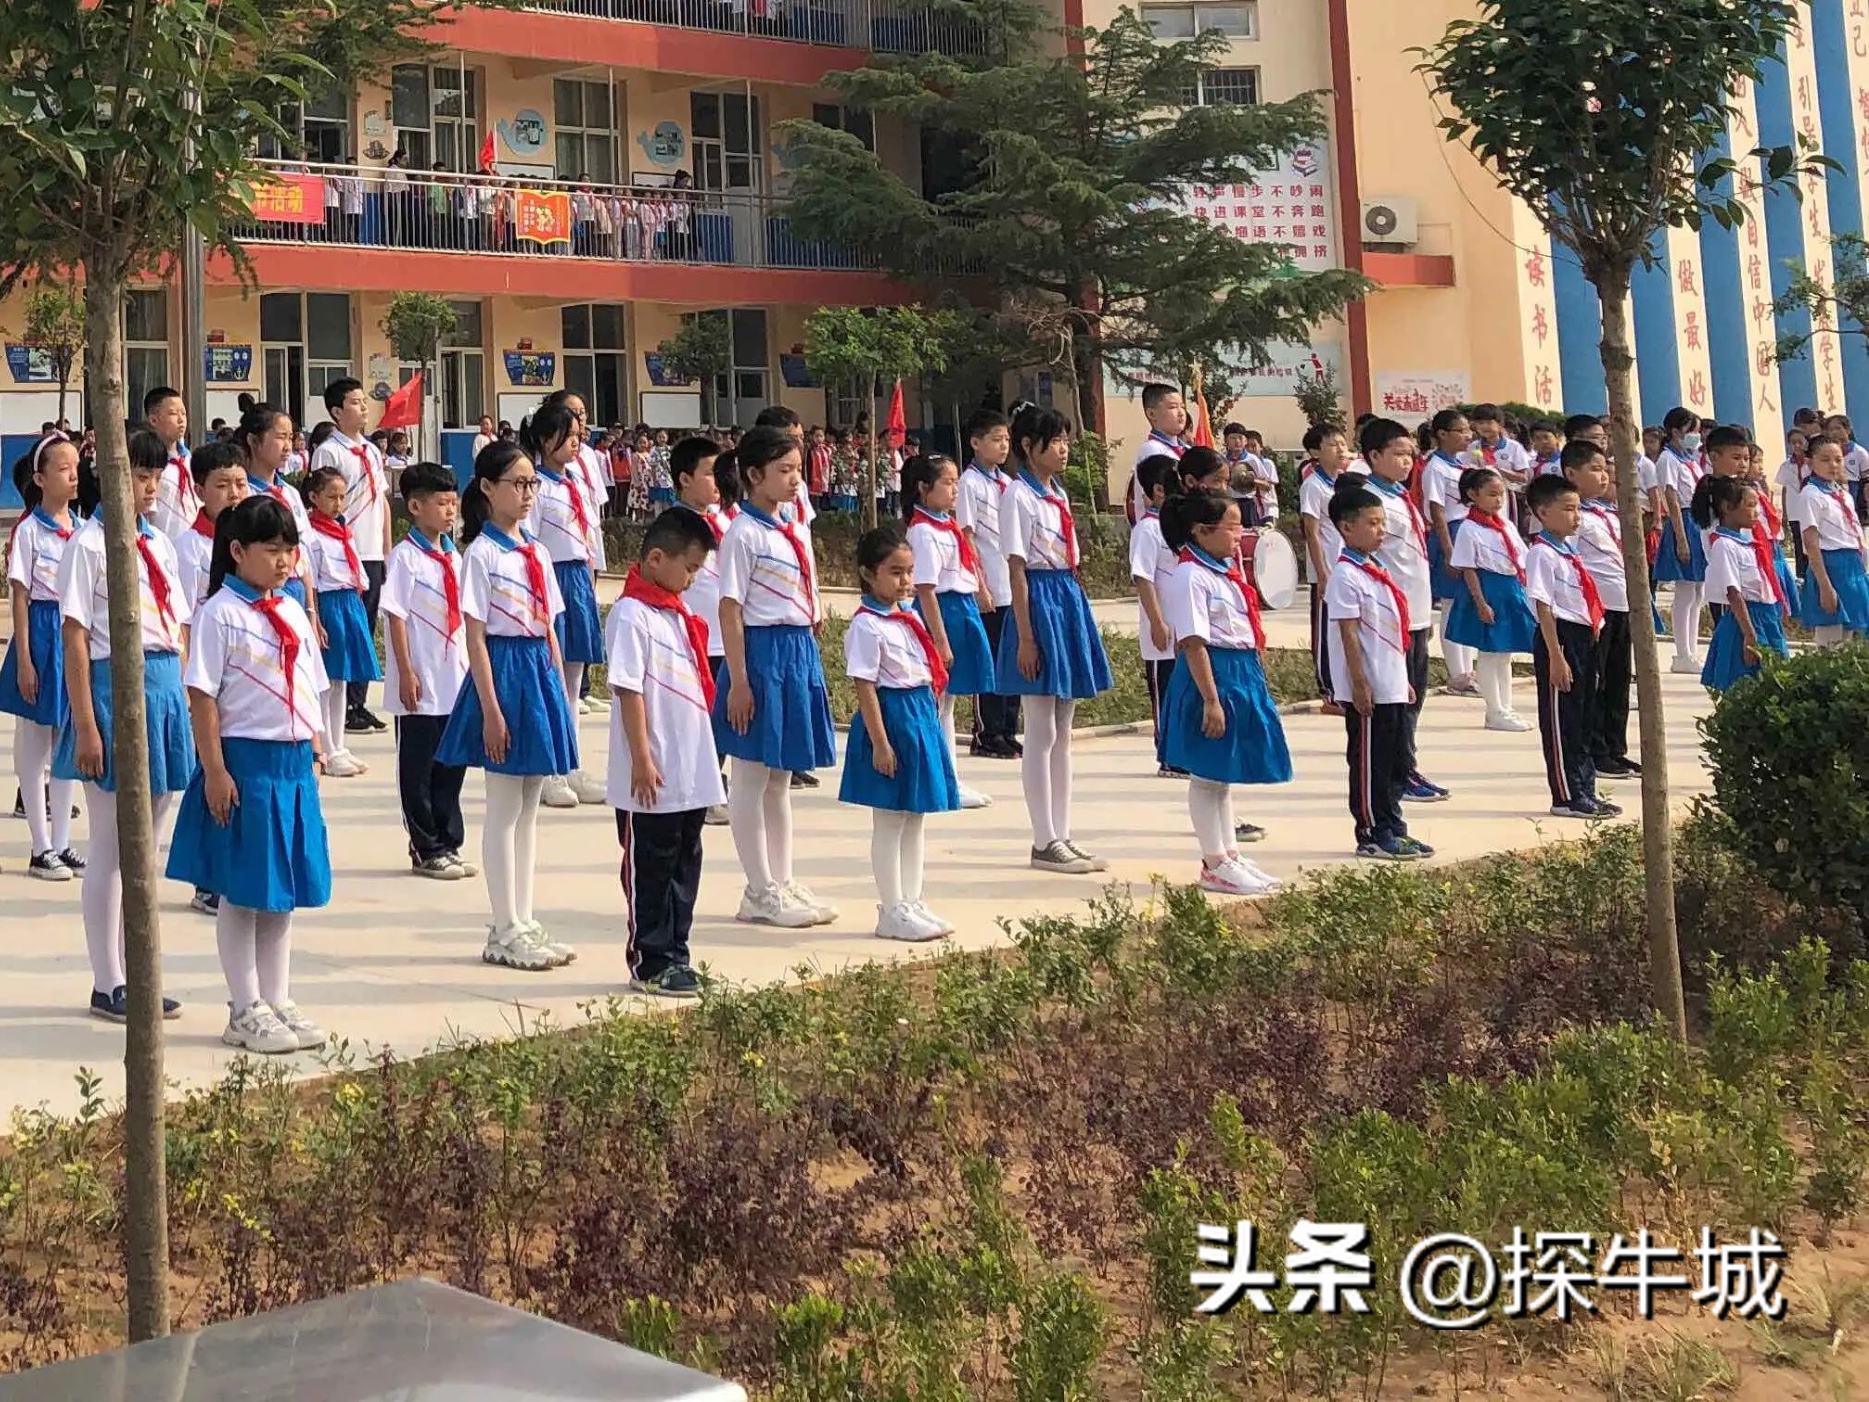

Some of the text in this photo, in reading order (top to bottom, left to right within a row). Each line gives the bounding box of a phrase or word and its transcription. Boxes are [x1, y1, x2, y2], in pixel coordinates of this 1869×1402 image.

[1219, 224, 1327, 238] 细语不嬉戏
[1678, 259, 1704, 406] 做最好
